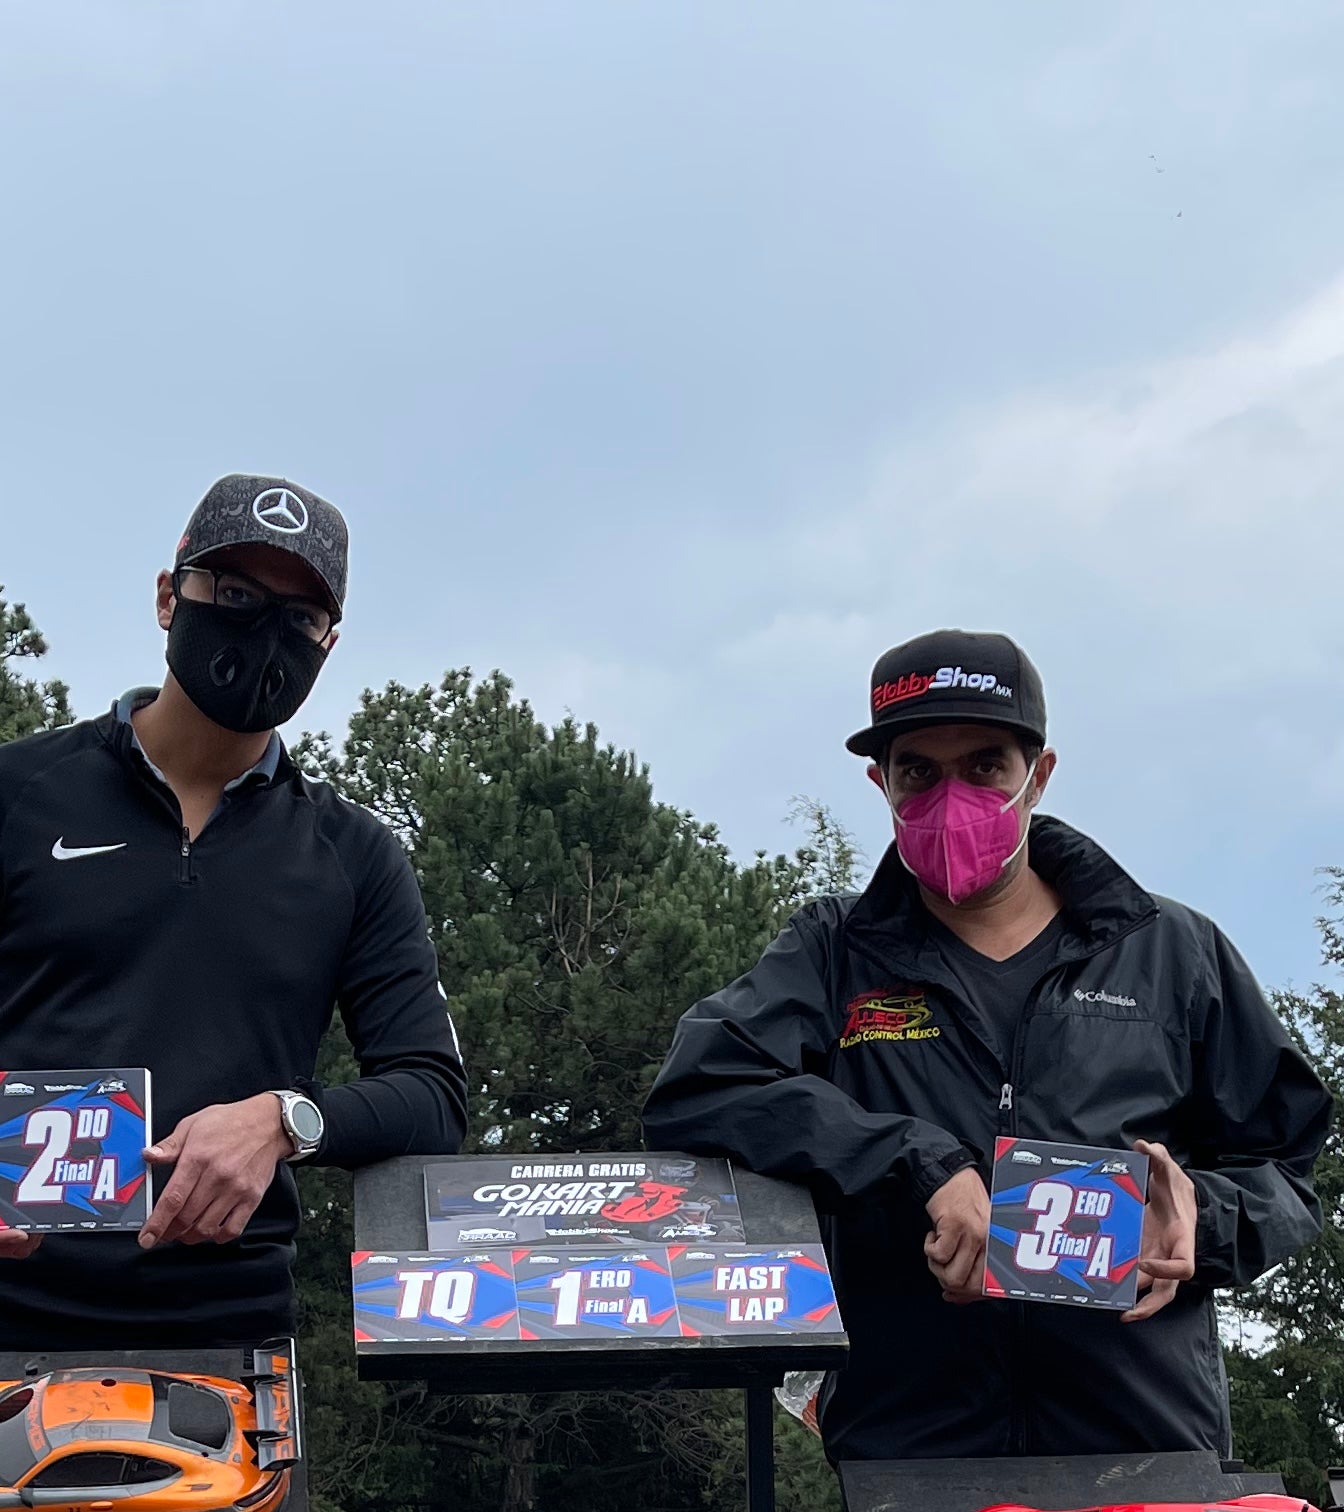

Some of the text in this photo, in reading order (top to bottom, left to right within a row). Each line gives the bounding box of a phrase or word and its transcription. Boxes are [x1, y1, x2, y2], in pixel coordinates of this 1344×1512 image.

[1085, 989, 1136, 1006] Columbia
[863, 1030, 905, 1042] CONTROL
[54, 1159, 116, 1200] Final A
[510, 1163, 646, 1179] CARRERA GRATIS
[472, 1181, 636, 1203] GOKART
[498, 1200, 606, 1217] MANIA
[1052, 1231, 1112, 1278] Final A
[715, 1266, 786, 1291] FAST
[398, 1270, 475, 1325] TQ
[729, 1297, 785, 1322] LAP
[585, 1297, 648, 1324] Final A
